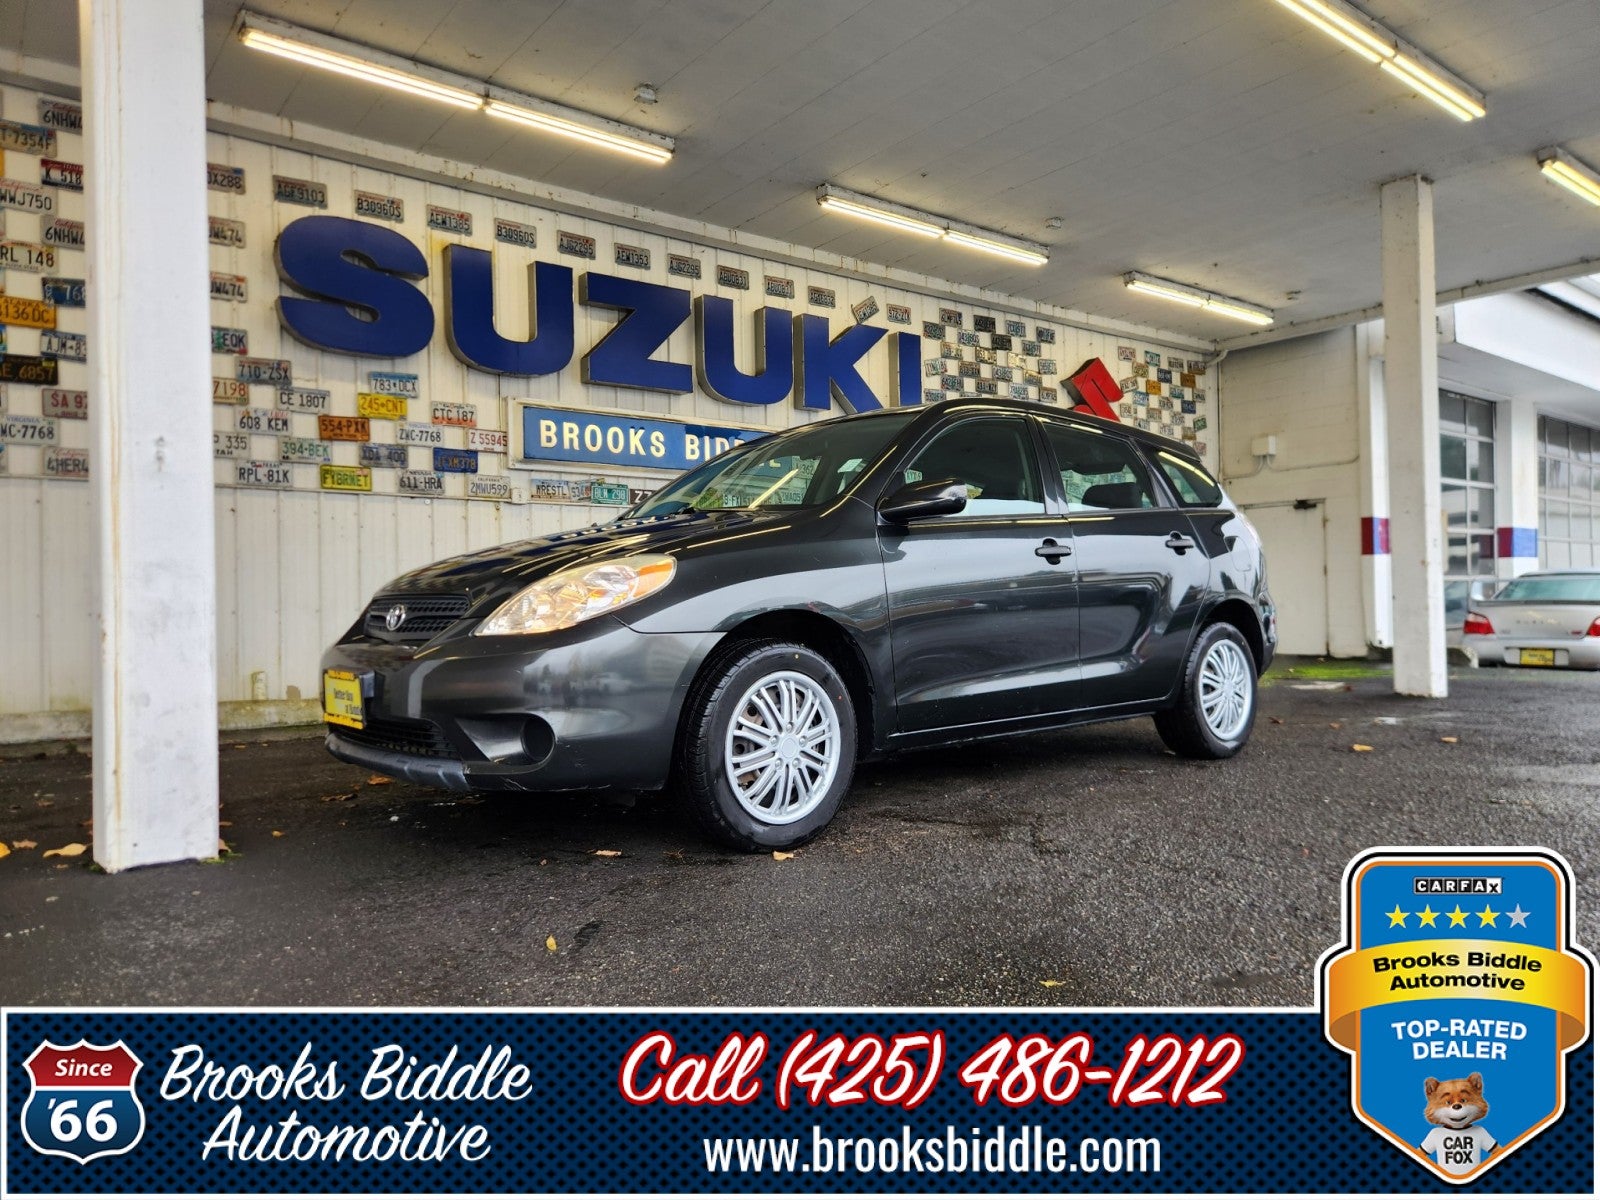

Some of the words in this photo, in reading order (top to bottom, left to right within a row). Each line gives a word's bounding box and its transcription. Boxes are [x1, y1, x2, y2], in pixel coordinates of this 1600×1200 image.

[27, 250, 54, 268] 148
[274, 214, 923, 414] SUZUKI
[280, 392, 295, 406] CE
[299, 394, 327, 409] 1807
[239, 416, 261, 431] 608
[267, 417, 289, 432] KEM
[433, 408, 452, 421] CTC
[456, 410, 474, 423] 187
[540, 419, 667, 458] BROOKS
